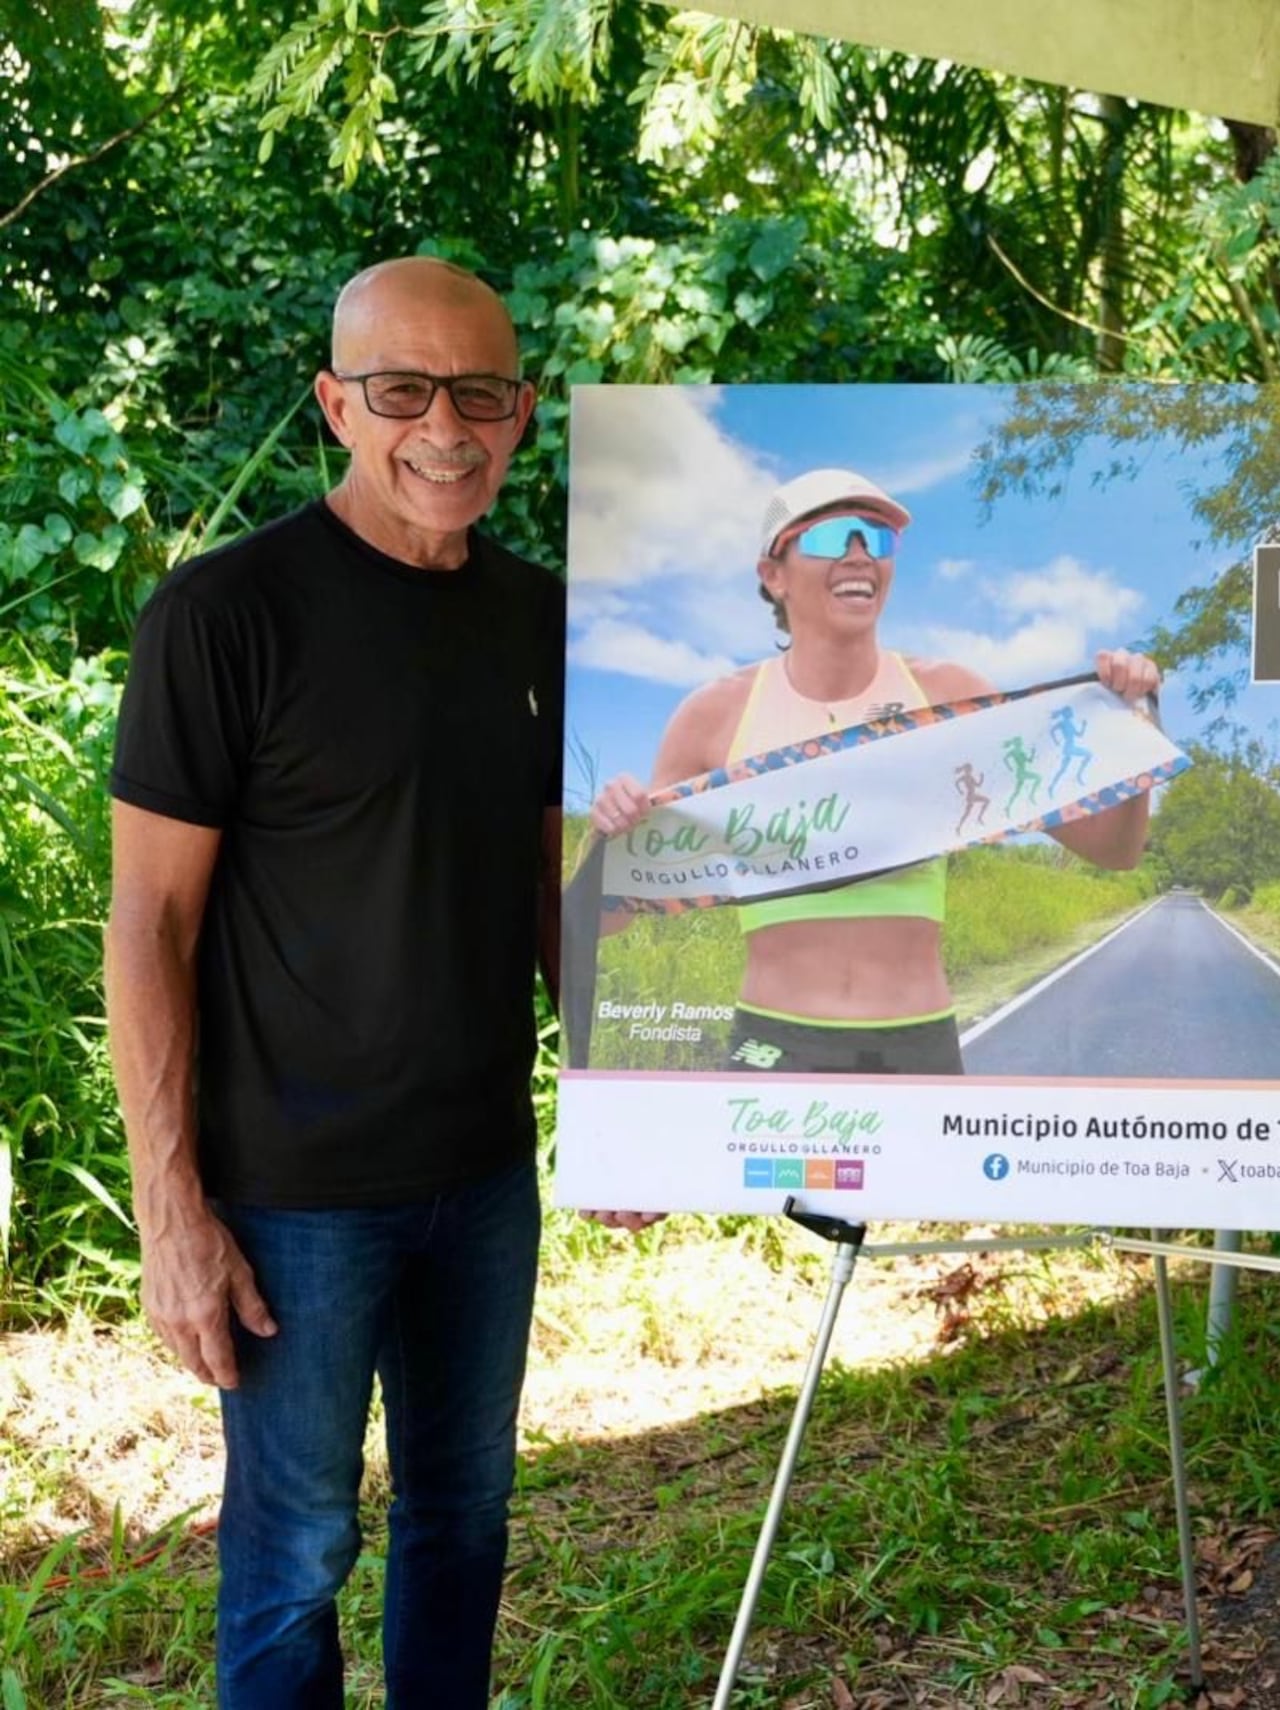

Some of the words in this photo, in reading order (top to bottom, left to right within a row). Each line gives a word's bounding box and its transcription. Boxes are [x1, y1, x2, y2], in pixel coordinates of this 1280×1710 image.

[725, 793, 850, 860] Baja
[631, 862, 729, 886] ORGULLO
[751, 845, 860, 876] LLANERO
[598, 1001, 666, 1022] Beverly
[671, 1002, 736, 1021] Ramos
[629, 1022, 703, 1043] Fondista
[727, 1098, 797, 1133] Toa
[802, 1100, 885, 1146] Baja
[942, 1114, 1078, 1142] Municipio
[1085, 1115, 1228, 1140] Autónomo
[1236, 1118, 1271, 1141] de
[726, 1142, 799, 1153] ORGULLO
[812, 1144, 882, 1155] LLANERO
[1017, 1160, 1095, 1177] Municipio
[1099, 1161, 1120, 1176] de
[1124, 1162, 1151, 1177] Toa
[1155, 1162, 1190, 1180] Baja
